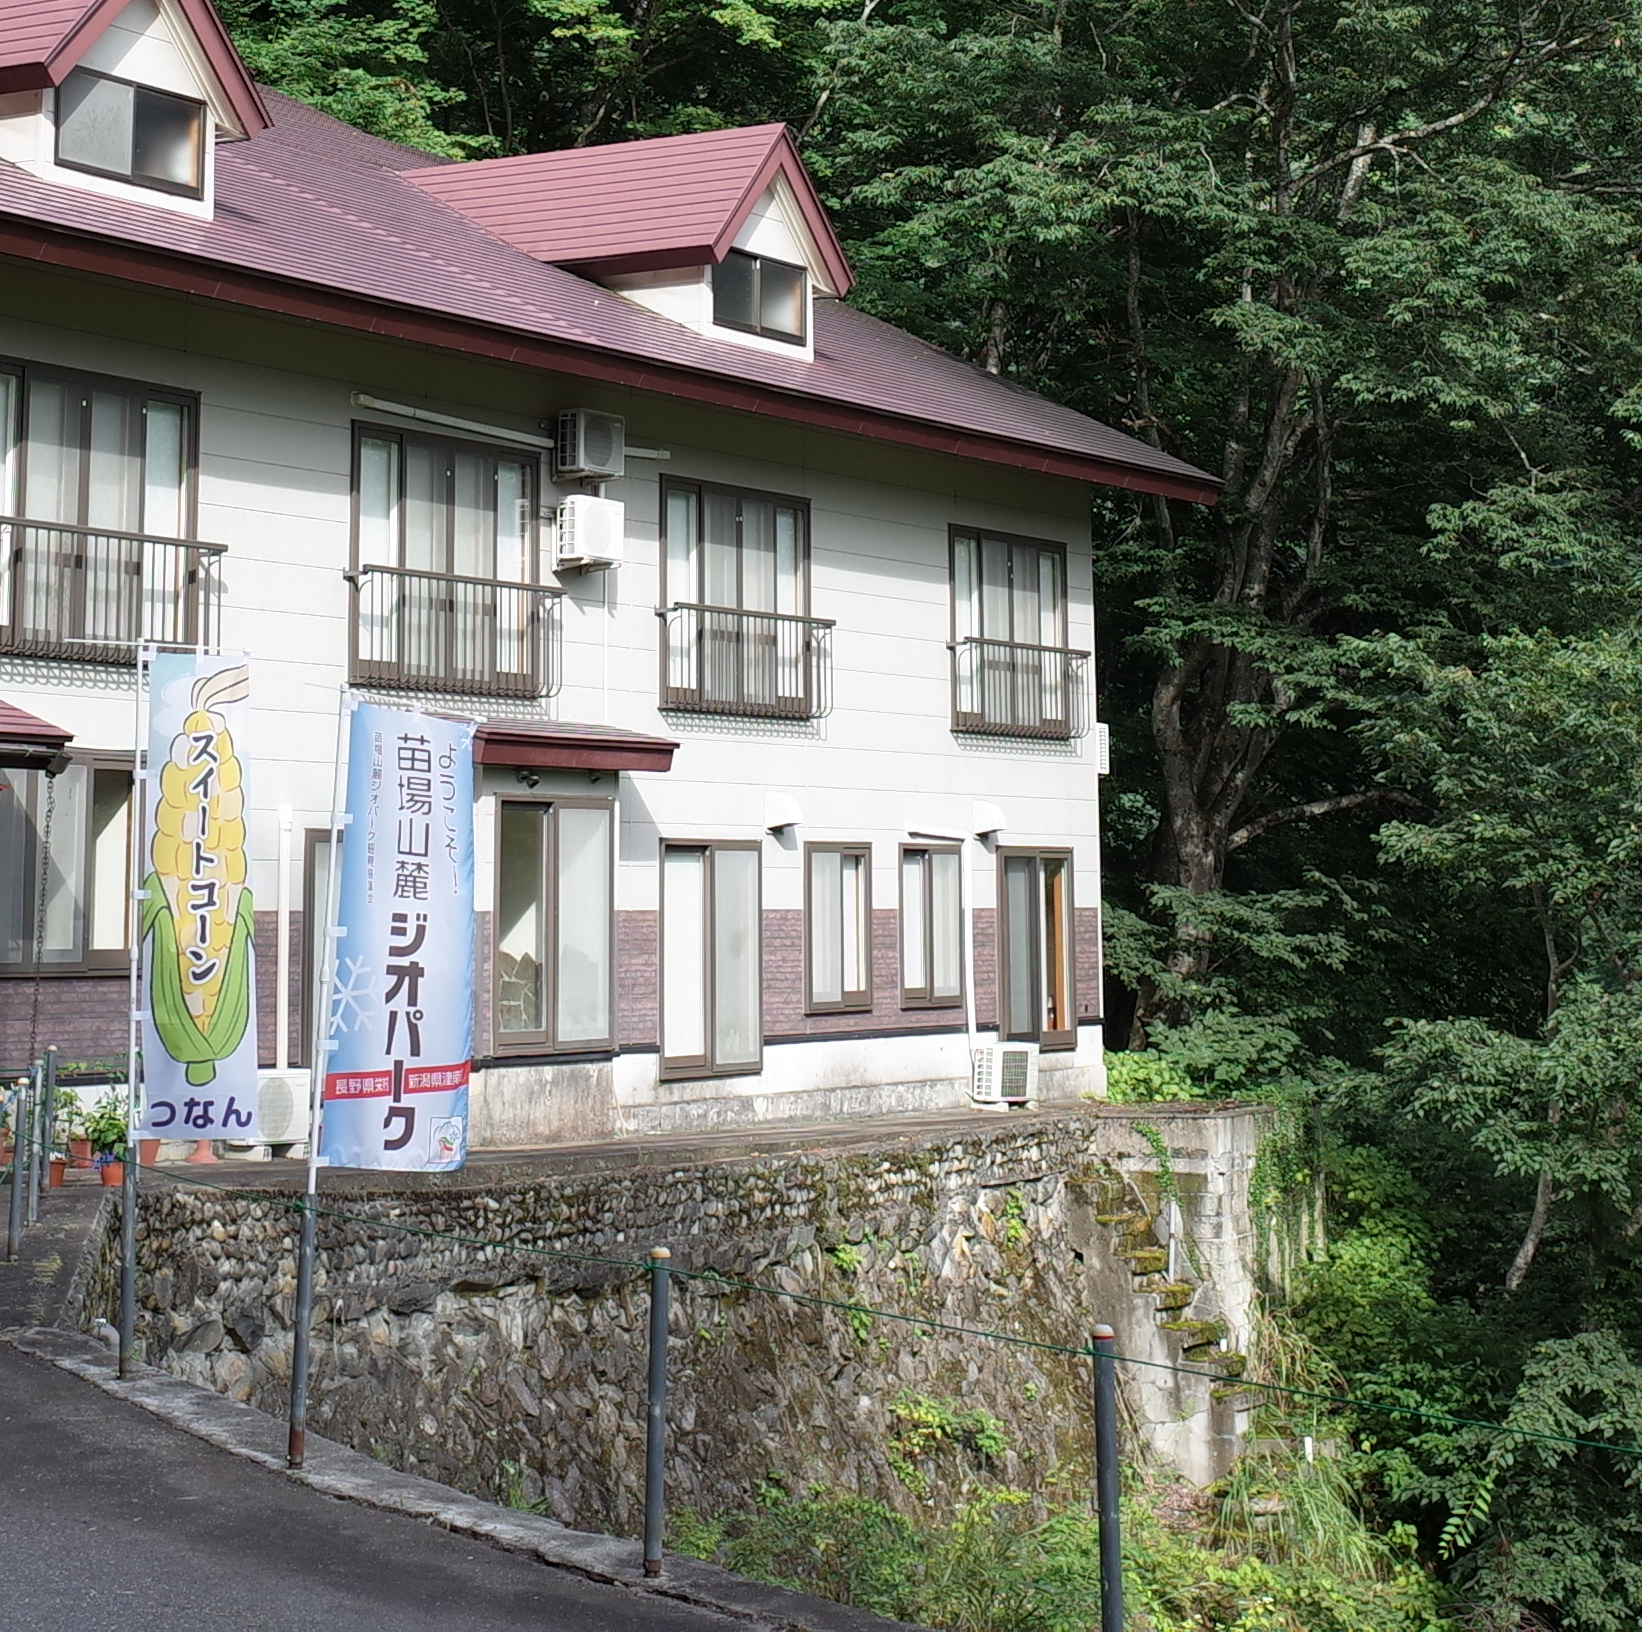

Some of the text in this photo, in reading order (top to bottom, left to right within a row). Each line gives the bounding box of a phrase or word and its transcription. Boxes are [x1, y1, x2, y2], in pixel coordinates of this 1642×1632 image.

[189, 734, 219, 982] スイートコーン
[383, 732, 433, 1151] 苗場山麓ジオパーク
[150, 1096, 253, 1129] つなん
